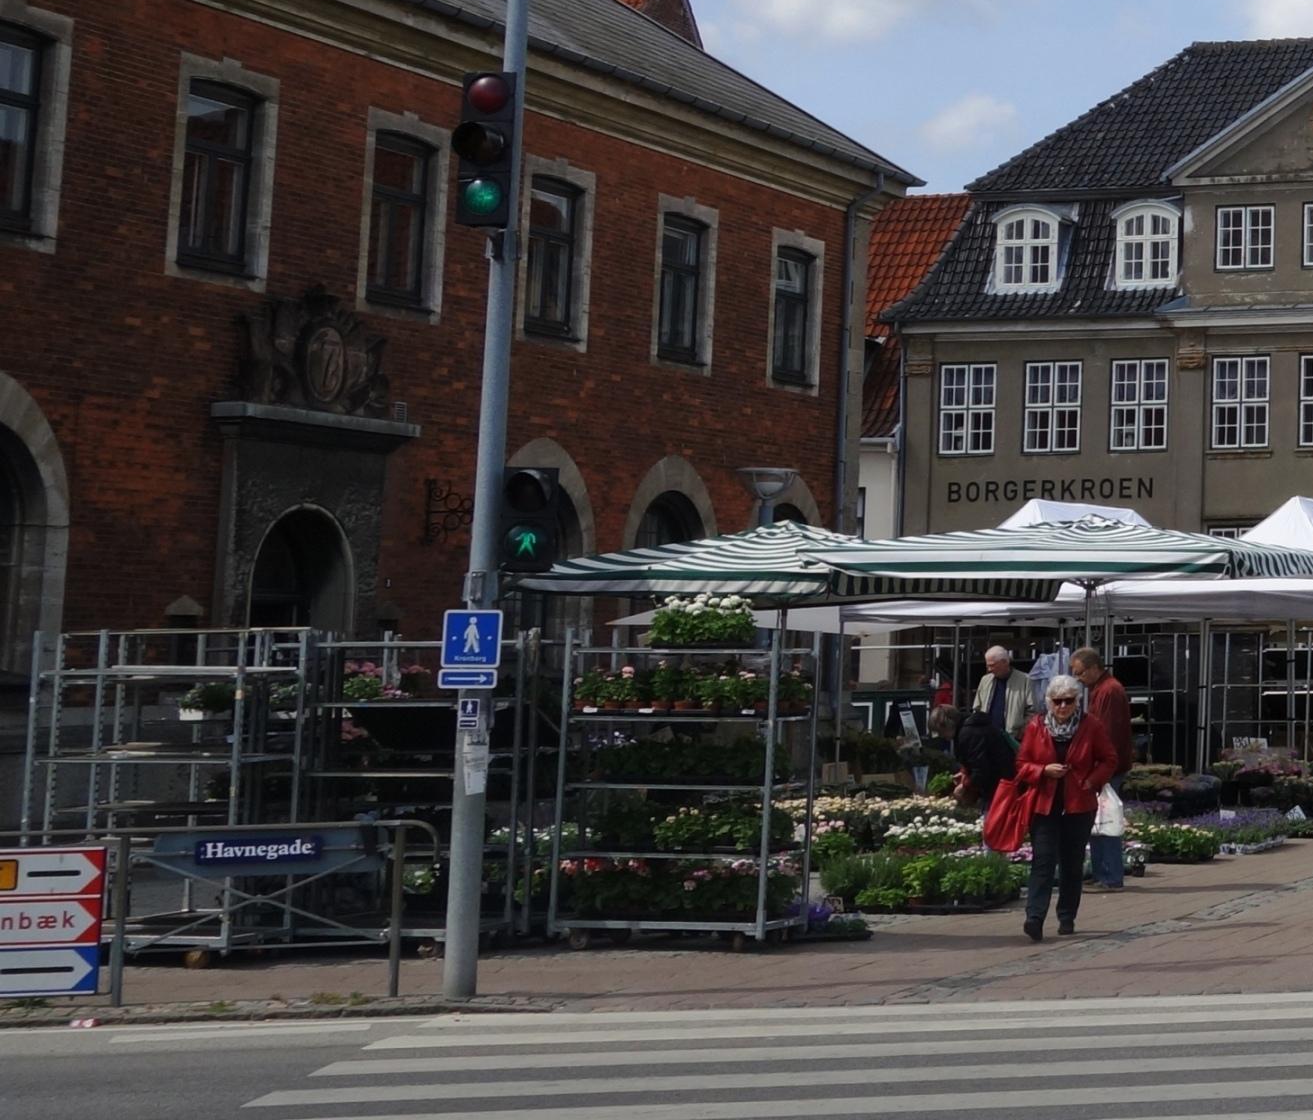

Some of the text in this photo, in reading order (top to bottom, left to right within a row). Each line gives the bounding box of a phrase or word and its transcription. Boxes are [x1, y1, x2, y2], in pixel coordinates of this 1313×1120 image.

[947, 477, 1153, 503] BORGERKROEN
[205, 839, 312, 860] Havnegade
[1, 910, 75, 930] nbæk
